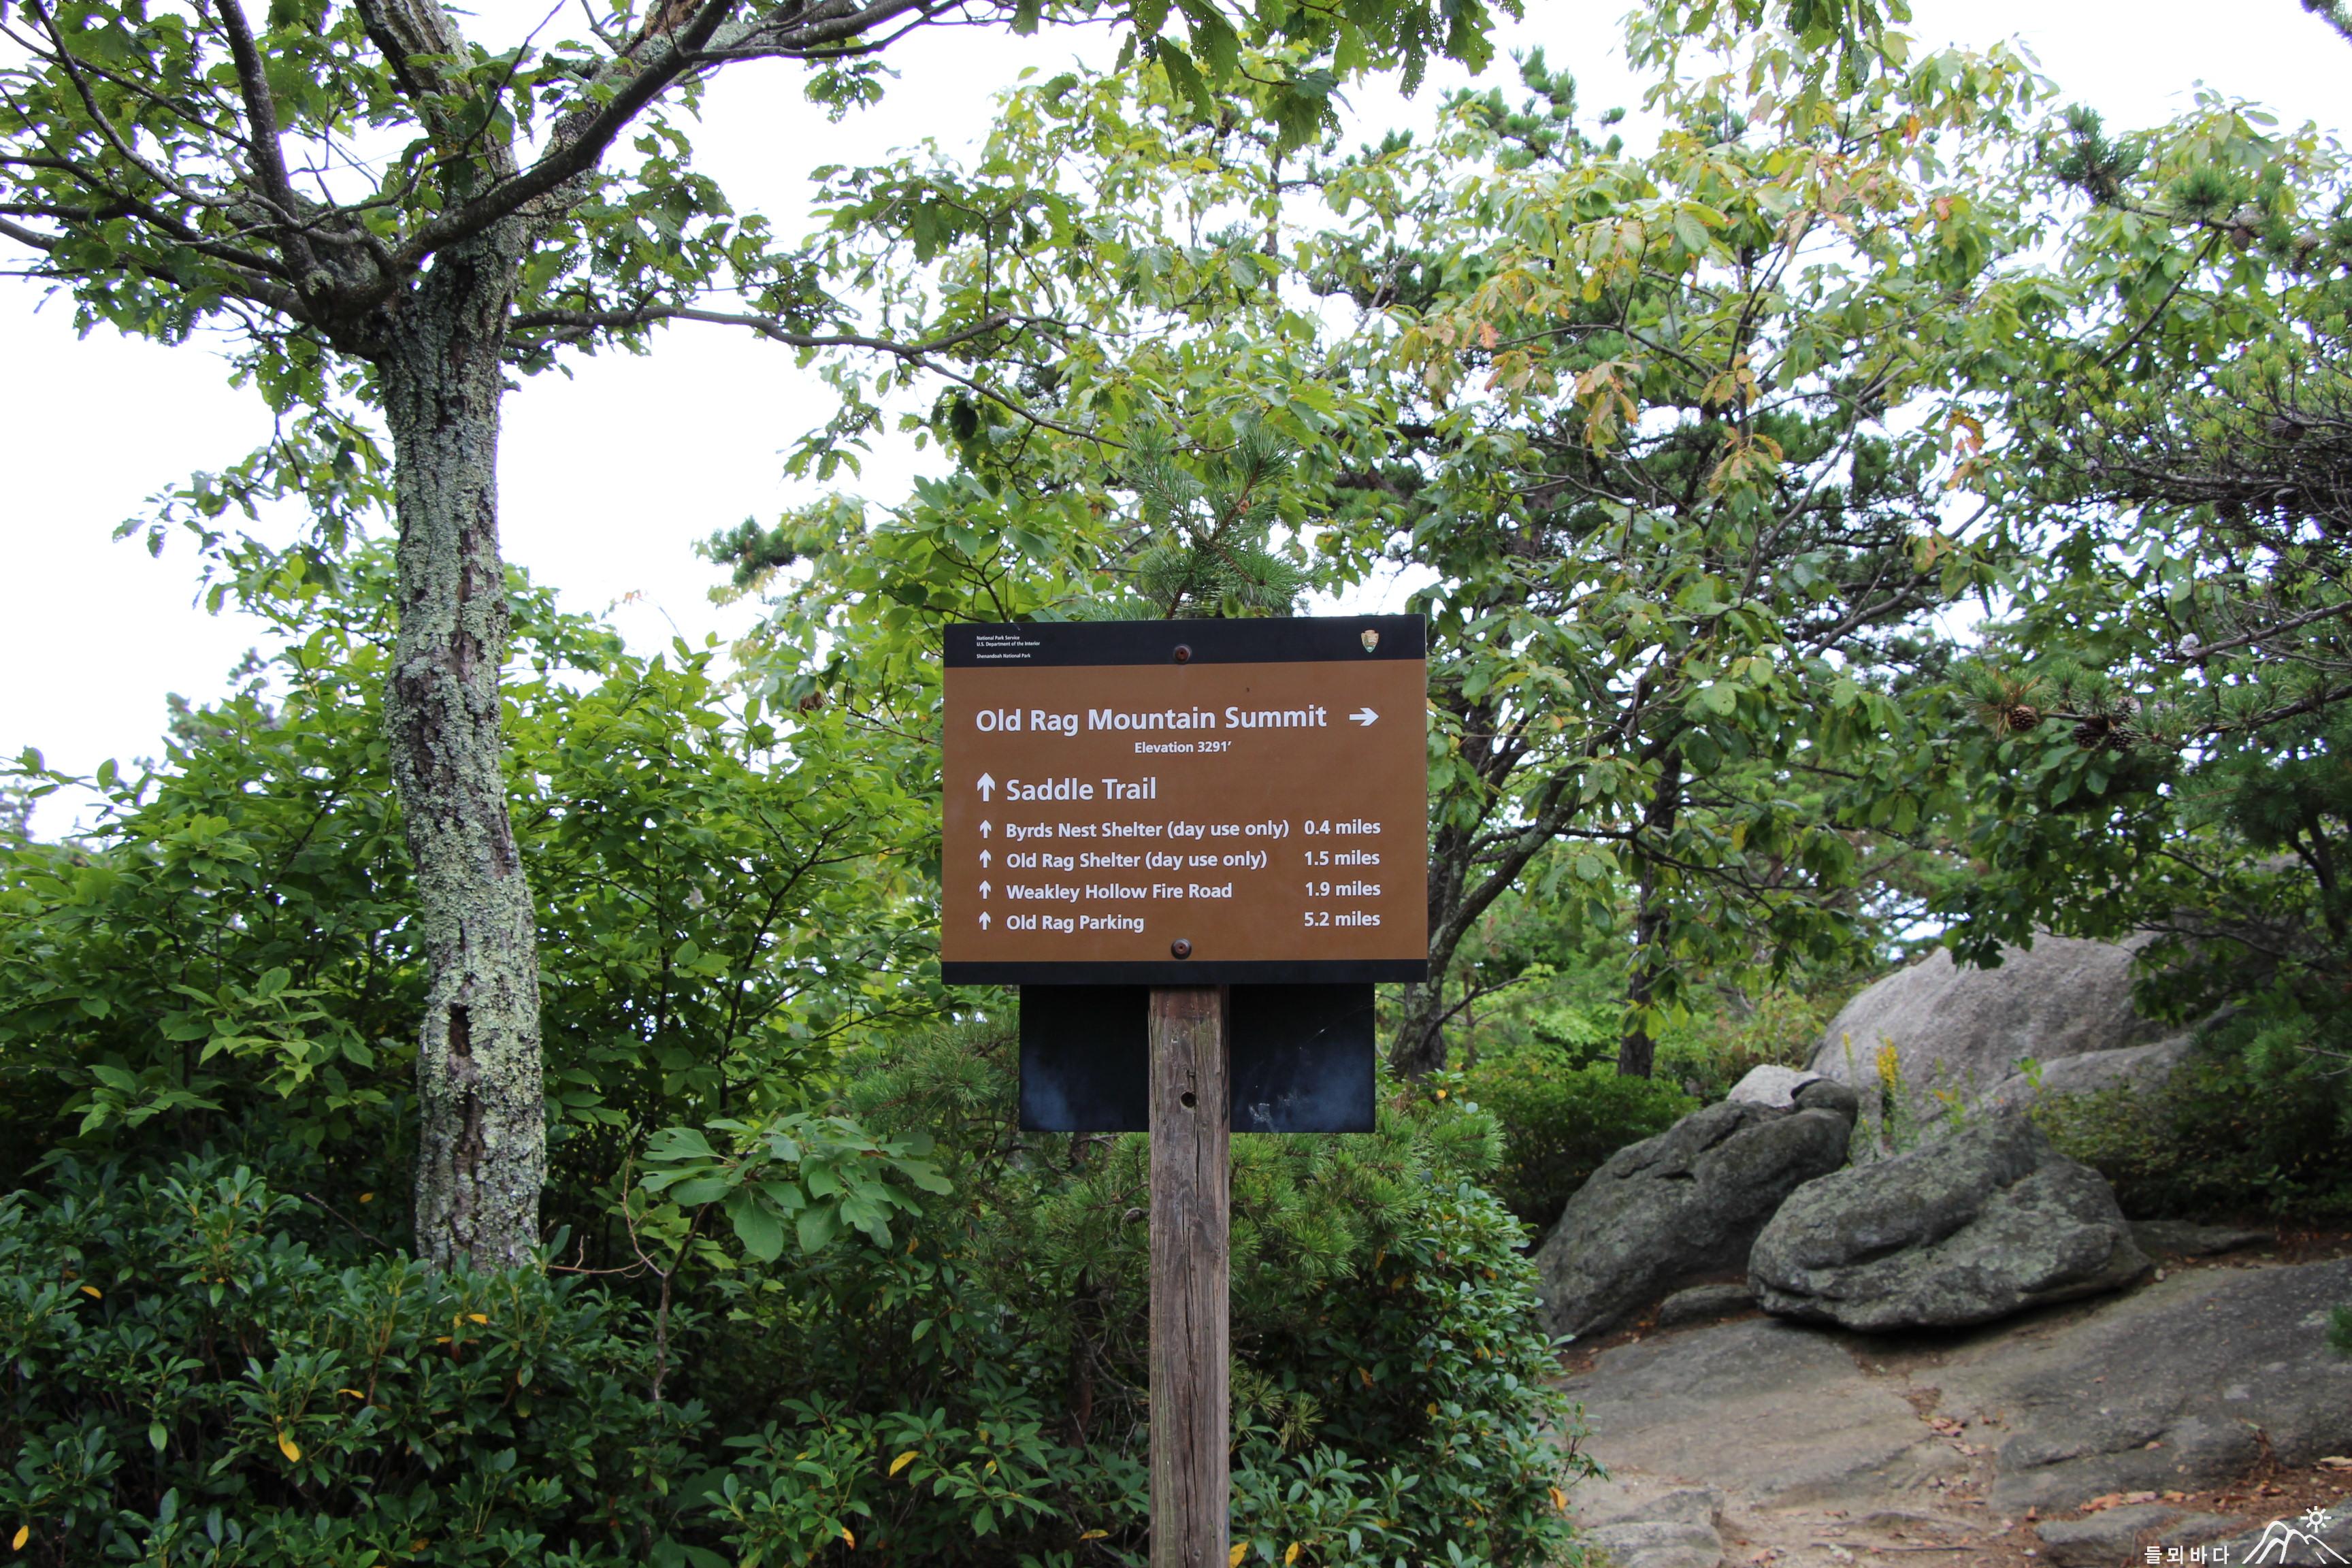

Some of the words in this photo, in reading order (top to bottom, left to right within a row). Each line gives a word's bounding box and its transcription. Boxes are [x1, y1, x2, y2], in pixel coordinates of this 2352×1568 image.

[977, 709, 1020, 731] Old
[1031, 710, 1078, 736] Rag
[1089, 707, 1215, 730] Mountain
[1226, 704, 1326, 728] Summit
[1135, 742, 1193, 753] Elevation
[1007, 778, 1093, 800] Saddle
[1102, 777, 1156, 799] Trail
[1007, 823, 1052, 841] Byrds
[1059, 823, 1096, 837] Nest
[1102, 821, 1162, 836] Shelter
[1168, 821, 1205, 840] (day
[1211, 825, 1239, 836] use
[1245, 820, 1288, 838] only)
[1305, 820, 1330, 834] 0.4
[1336, 819, 1380, 834] miles
[1007, 853, 1036, 868] Old
[1043, 853, 1073, 871] Rag
[1080, 852, 1141, 867] Shelter
[1146, 852, 1183, 870] (day
[1189, 855, 1218, 866] use
[1224, 851, 1267, 870] only)
[1305, 851, 1328, 865] 1.5
[1335, 850, 1379, 865] miles
[1007, 884, 1080, 902] Weakley
[1086, 883, 1147, 898] Hollow
[1154, 883, 1183, 898] Fire
[1190, 883, 1232, 898] Road
[1306, 882, 1330, 896] 1.9
[1336, 881, 1380, 896] miles
[1007, 915, 1036, 930] Old
[1043, 915, 1073, 933] Rag
[1080, 915, 1143, 932] Parking
[1305, 912, 1329, 926] 5.2
[1336, 911, 1380, 926] miles
